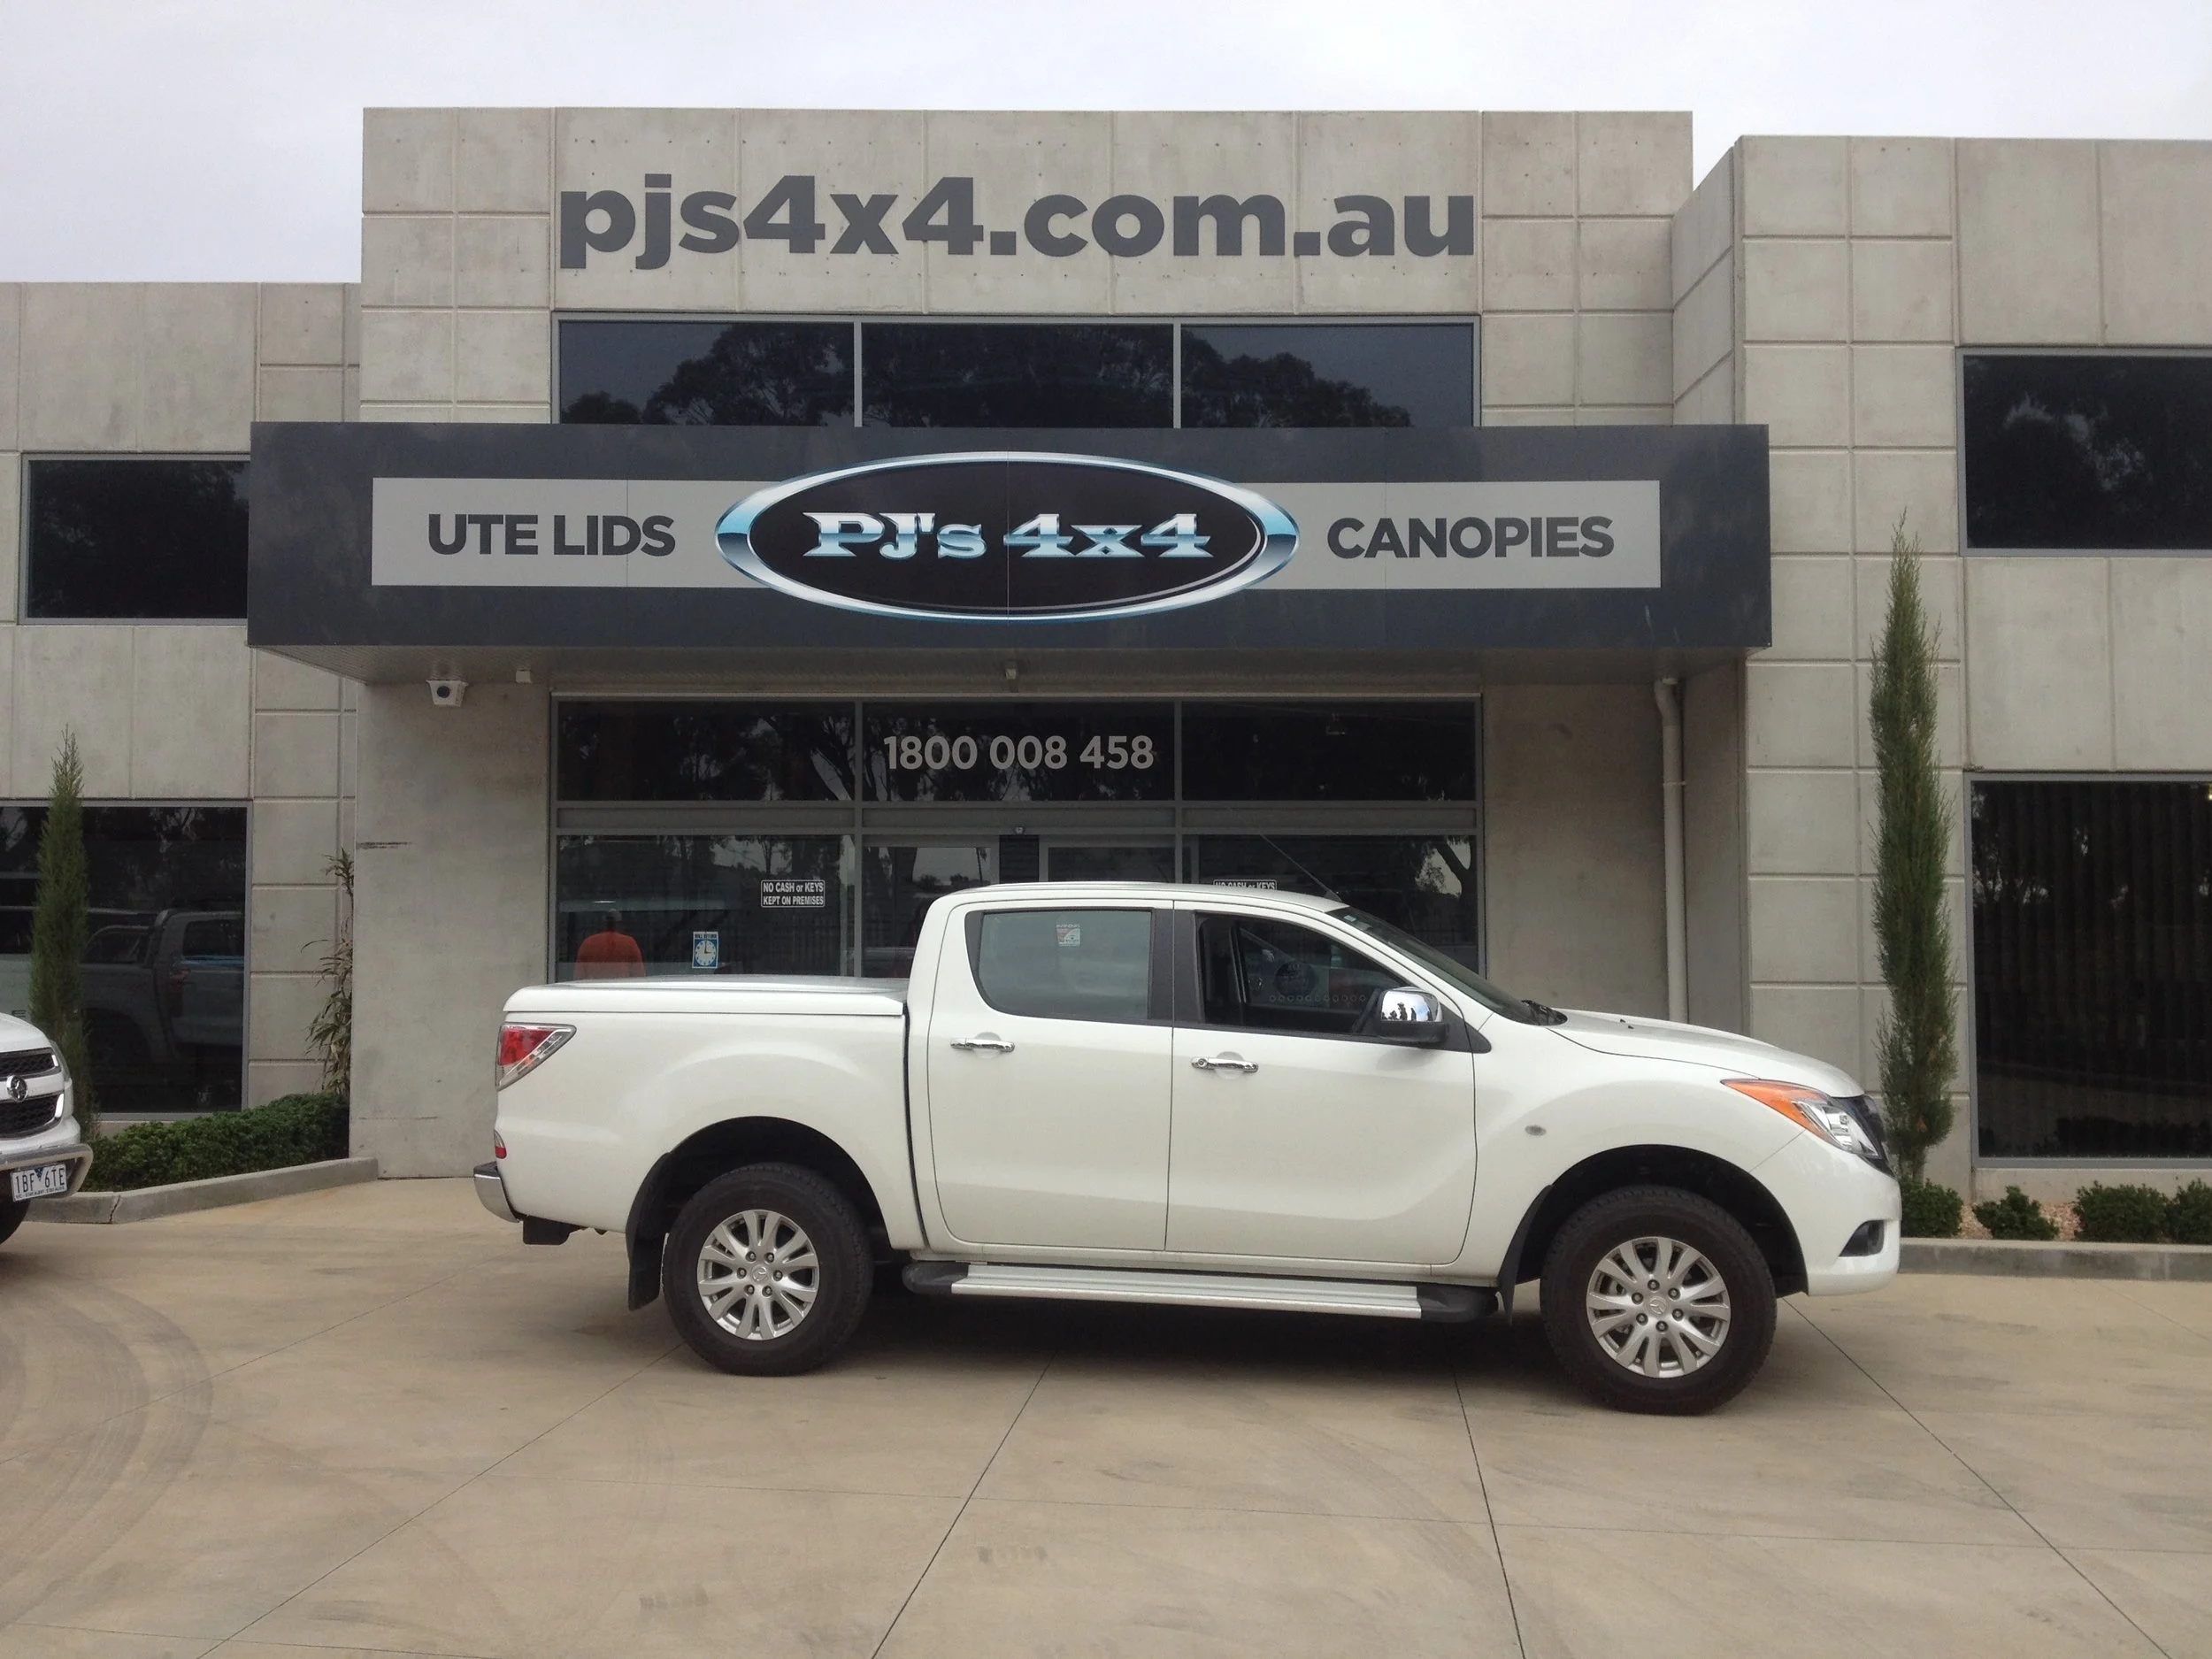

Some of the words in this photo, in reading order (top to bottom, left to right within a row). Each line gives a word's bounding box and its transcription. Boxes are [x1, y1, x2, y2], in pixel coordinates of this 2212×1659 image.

[559, 173, 1475, 271] pjs4x4.com.au
[428, 513, 539, 556] UTE
[553, 514, 676, 557] LIDS
[802, 511, 987, 559] PJ's
[1002, 512, 1215, 559] 4x4
[1327, 516, 1616, 559] CANOPIES
[883, 735, 978, 770] 1800
[989, 735, 1068, 770] 008
[1079, 735, 1154, 770] 458
[763, 882, 774, 893] NO
[775, 882, 795, 893] CASH
[804, 882, 824, 893] KEYS
[763, 895, 780, 905] KEPT
[781, 895, 791, 905] ON
[792, 895, 824, 905] PREMISES
[16, 1172, 35, 1194] 1BF
[45, 1168, 65, 1188] 6TE
